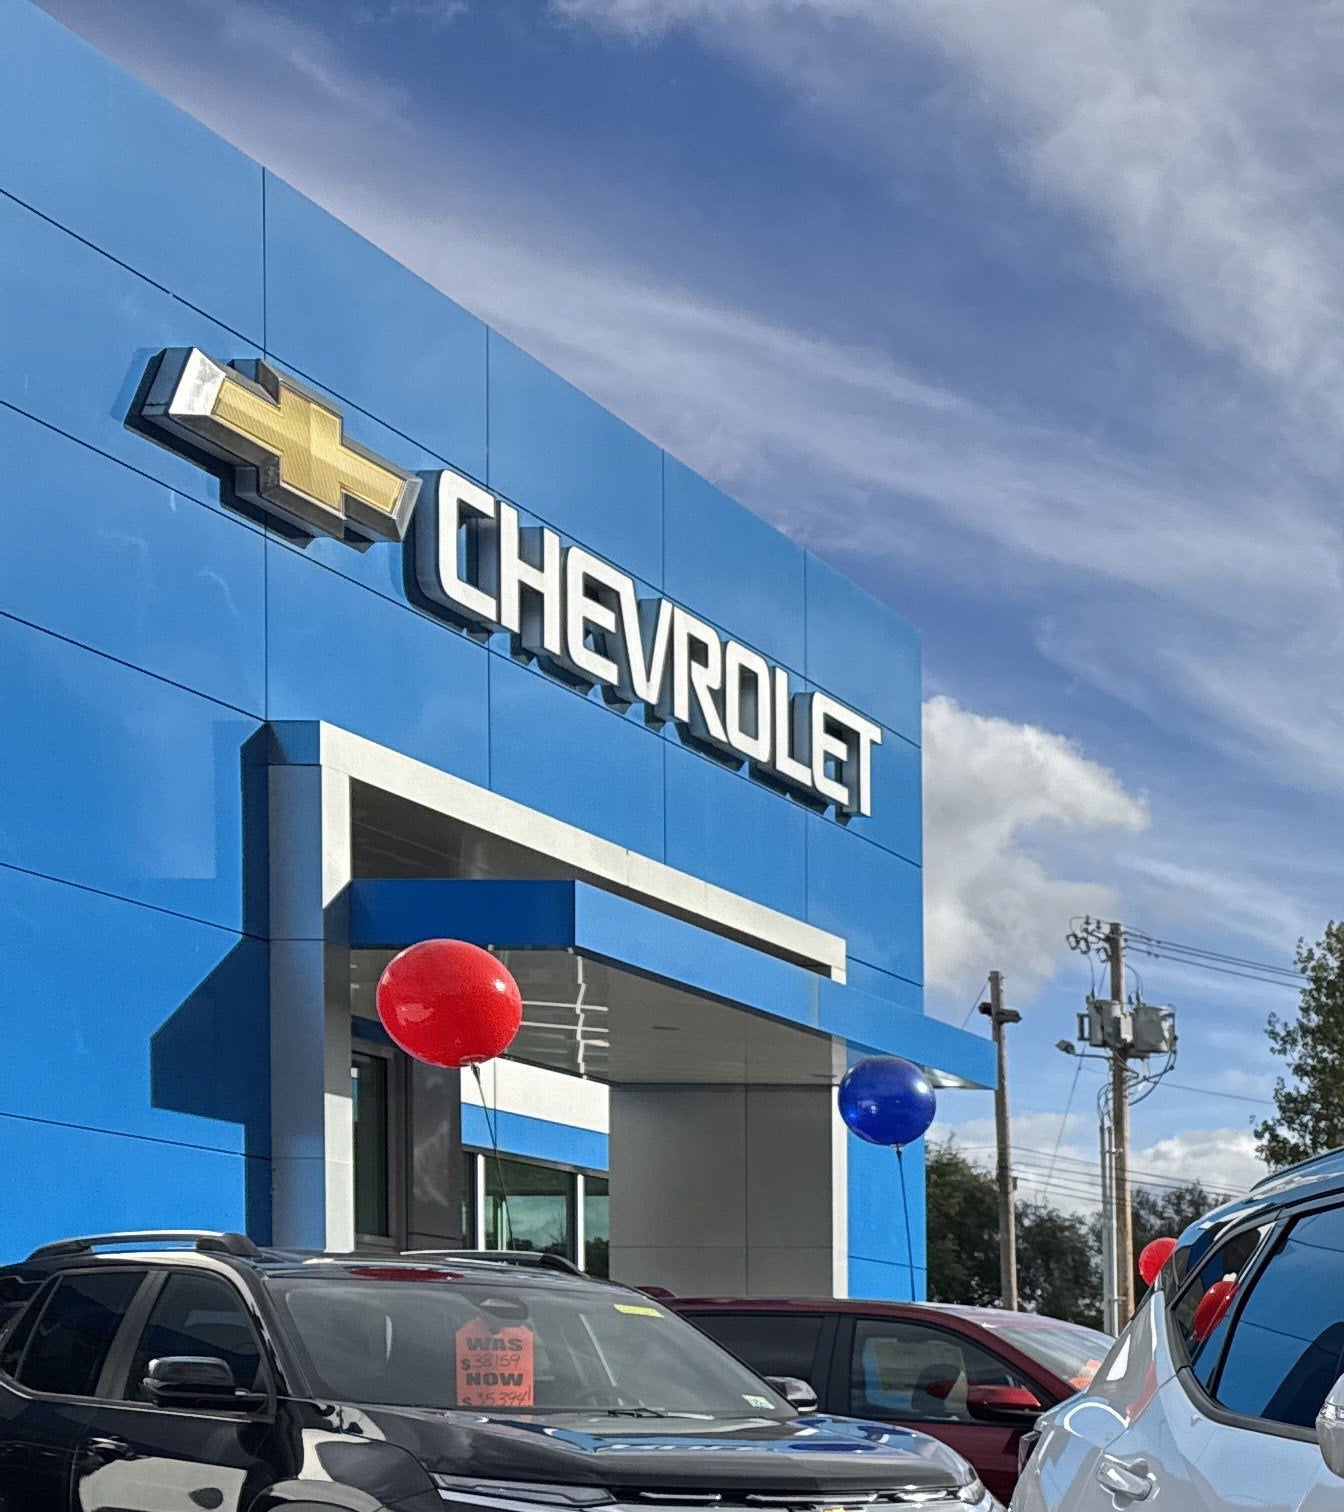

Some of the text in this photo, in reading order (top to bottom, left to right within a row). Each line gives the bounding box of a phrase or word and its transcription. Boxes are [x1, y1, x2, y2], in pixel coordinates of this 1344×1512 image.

[438, 468, 884, 818] CHEVROLET
[466, 1337, 523, 1351] WAS
[466, 1372, 523, 1386] NOW
